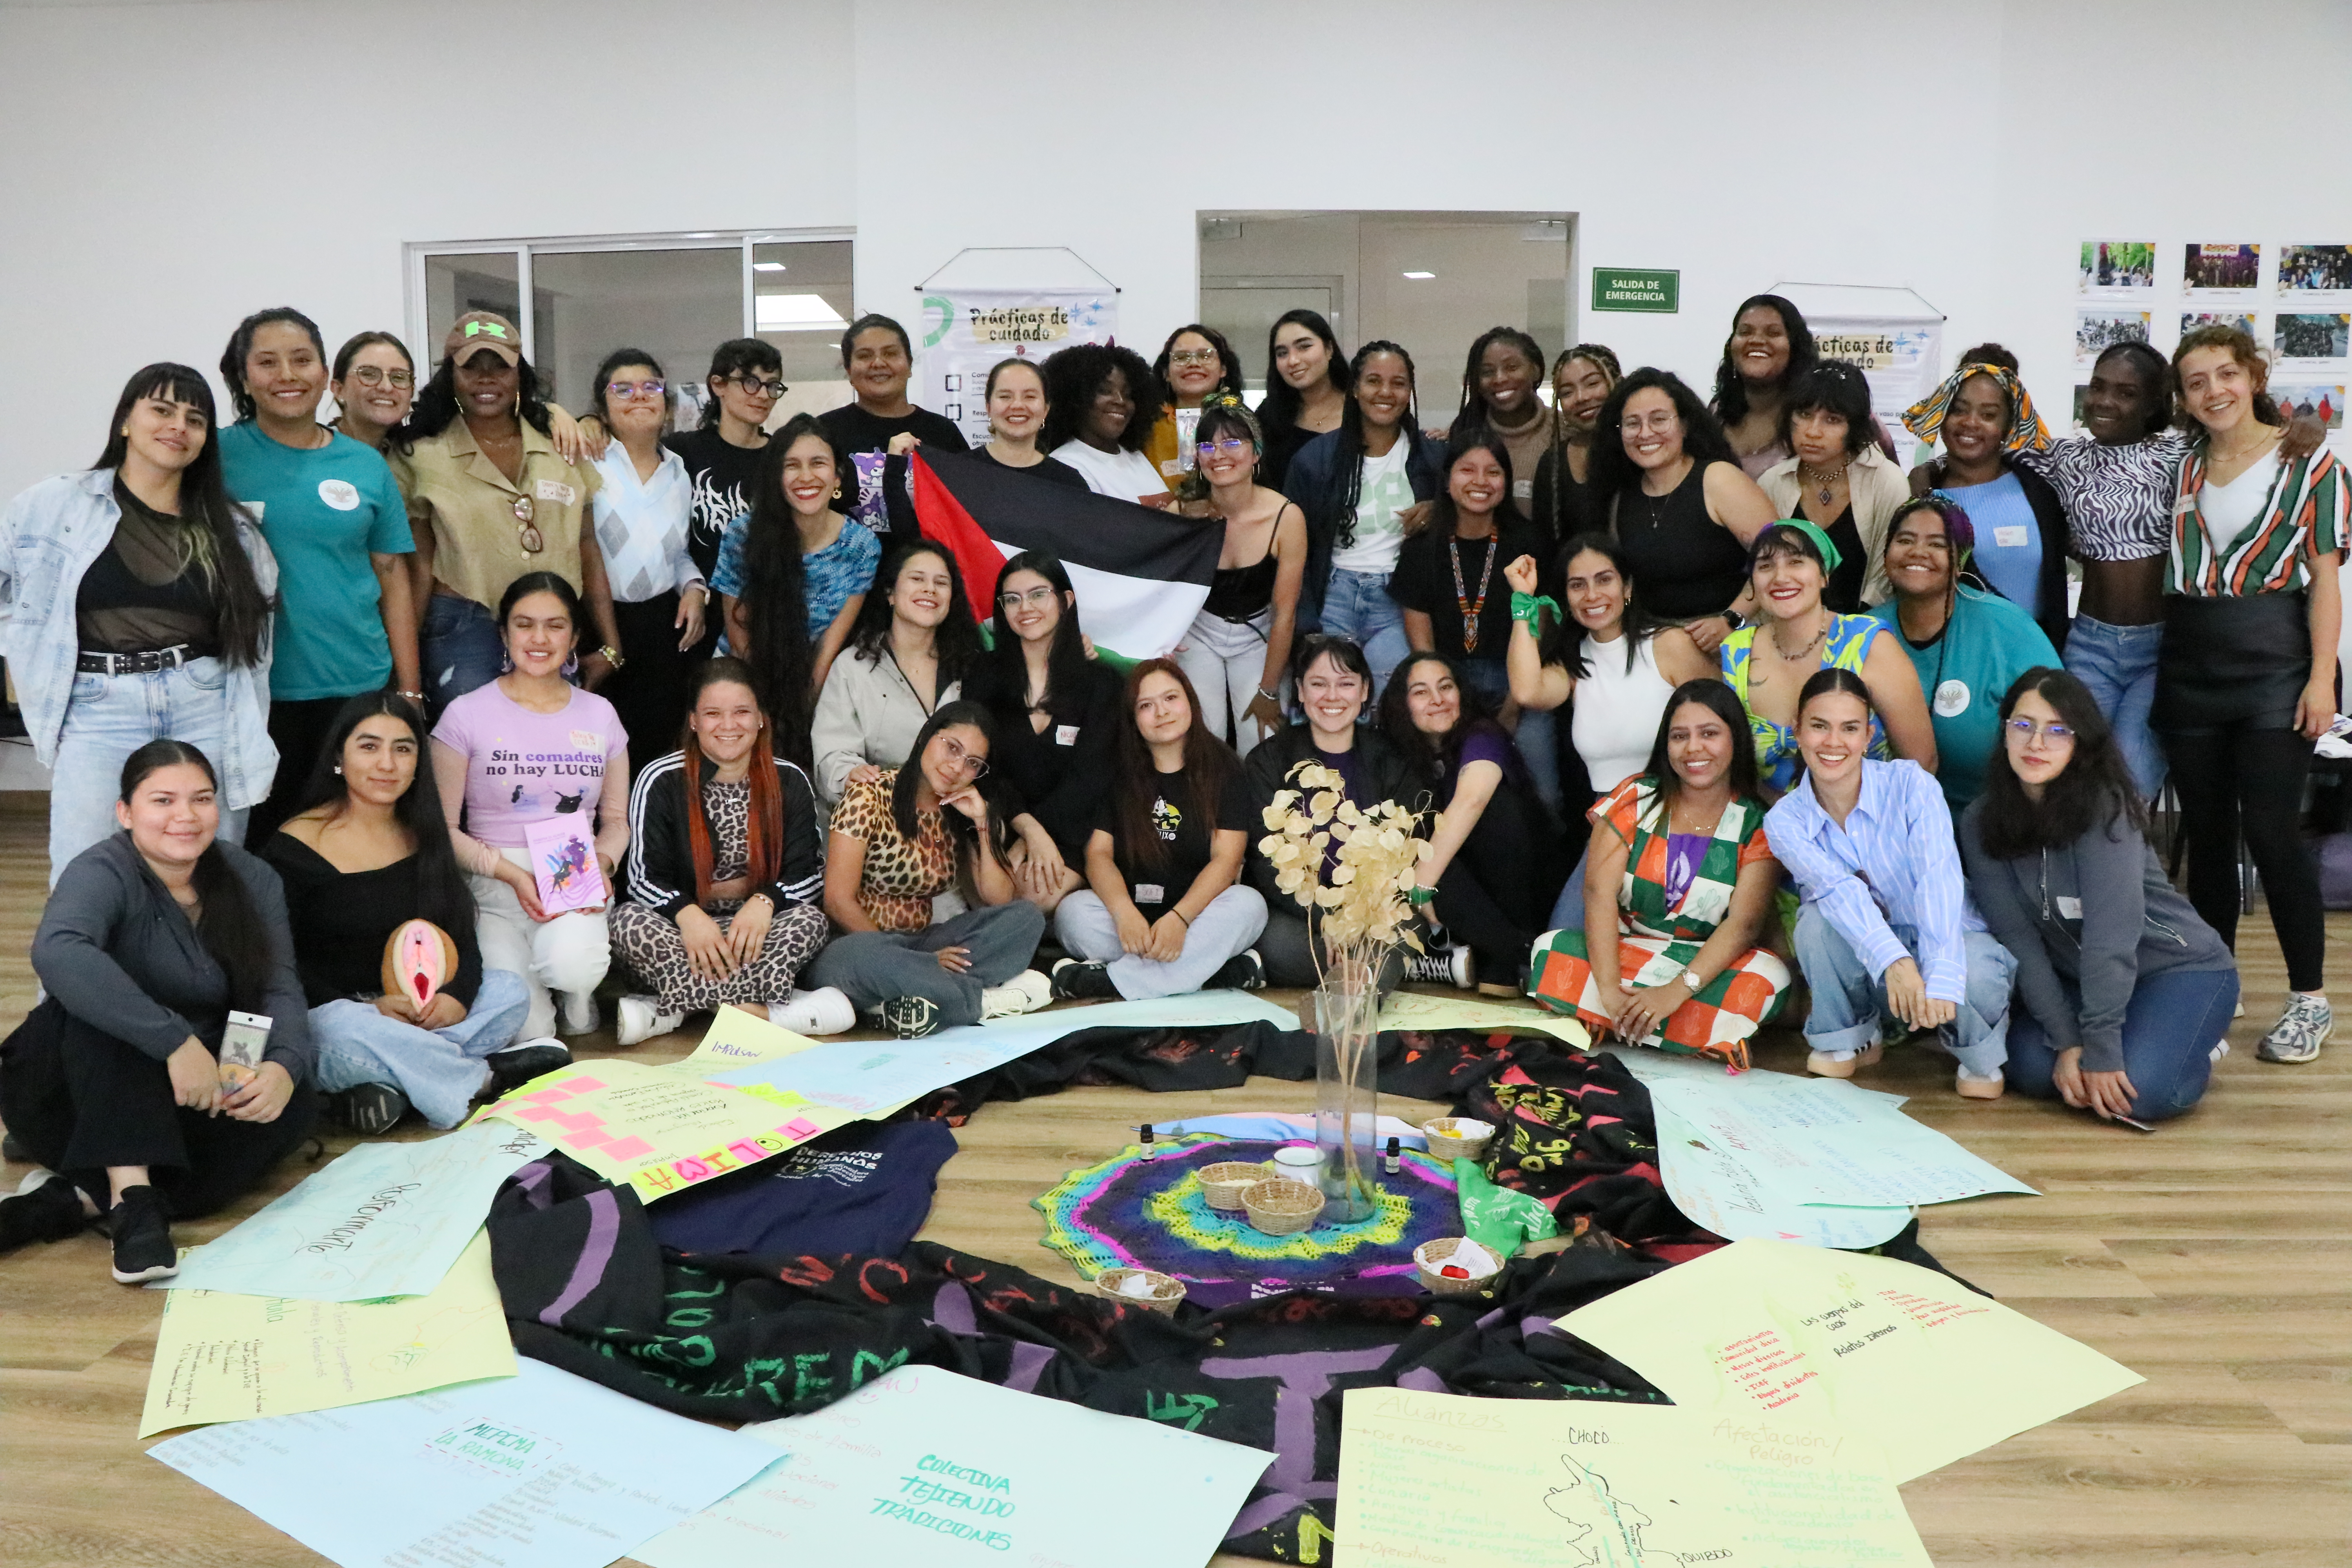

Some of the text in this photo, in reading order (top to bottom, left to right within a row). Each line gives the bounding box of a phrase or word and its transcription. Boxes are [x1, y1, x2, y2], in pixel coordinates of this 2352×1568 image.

[1612, 279, 1659, 289] SALIDA DE
[1606, 291, 1665, 301] EMERGENCIA
[970, 306, 1068, 328] Prácticas de
[989, 324, 1049, 341] cuidado
[1876, 335, 1893, 353] de
[492, 750, 602, 763] Sin comadres
[486, 765, 506, 775] no
[514, 763, 547, 777] hay
[1833, 1339, 1866, 1357] Relatos
[434, 1431, 525, 1470] LA RAMONA
[1749, 1445, 1814, 1468] Peligro
[916, 1454, 1010, 1495] COLECTIVA
[899, 1475, 1016, 1518] TEJIENDO
[869, 1498, 1013, 1551] TRADICIONES
